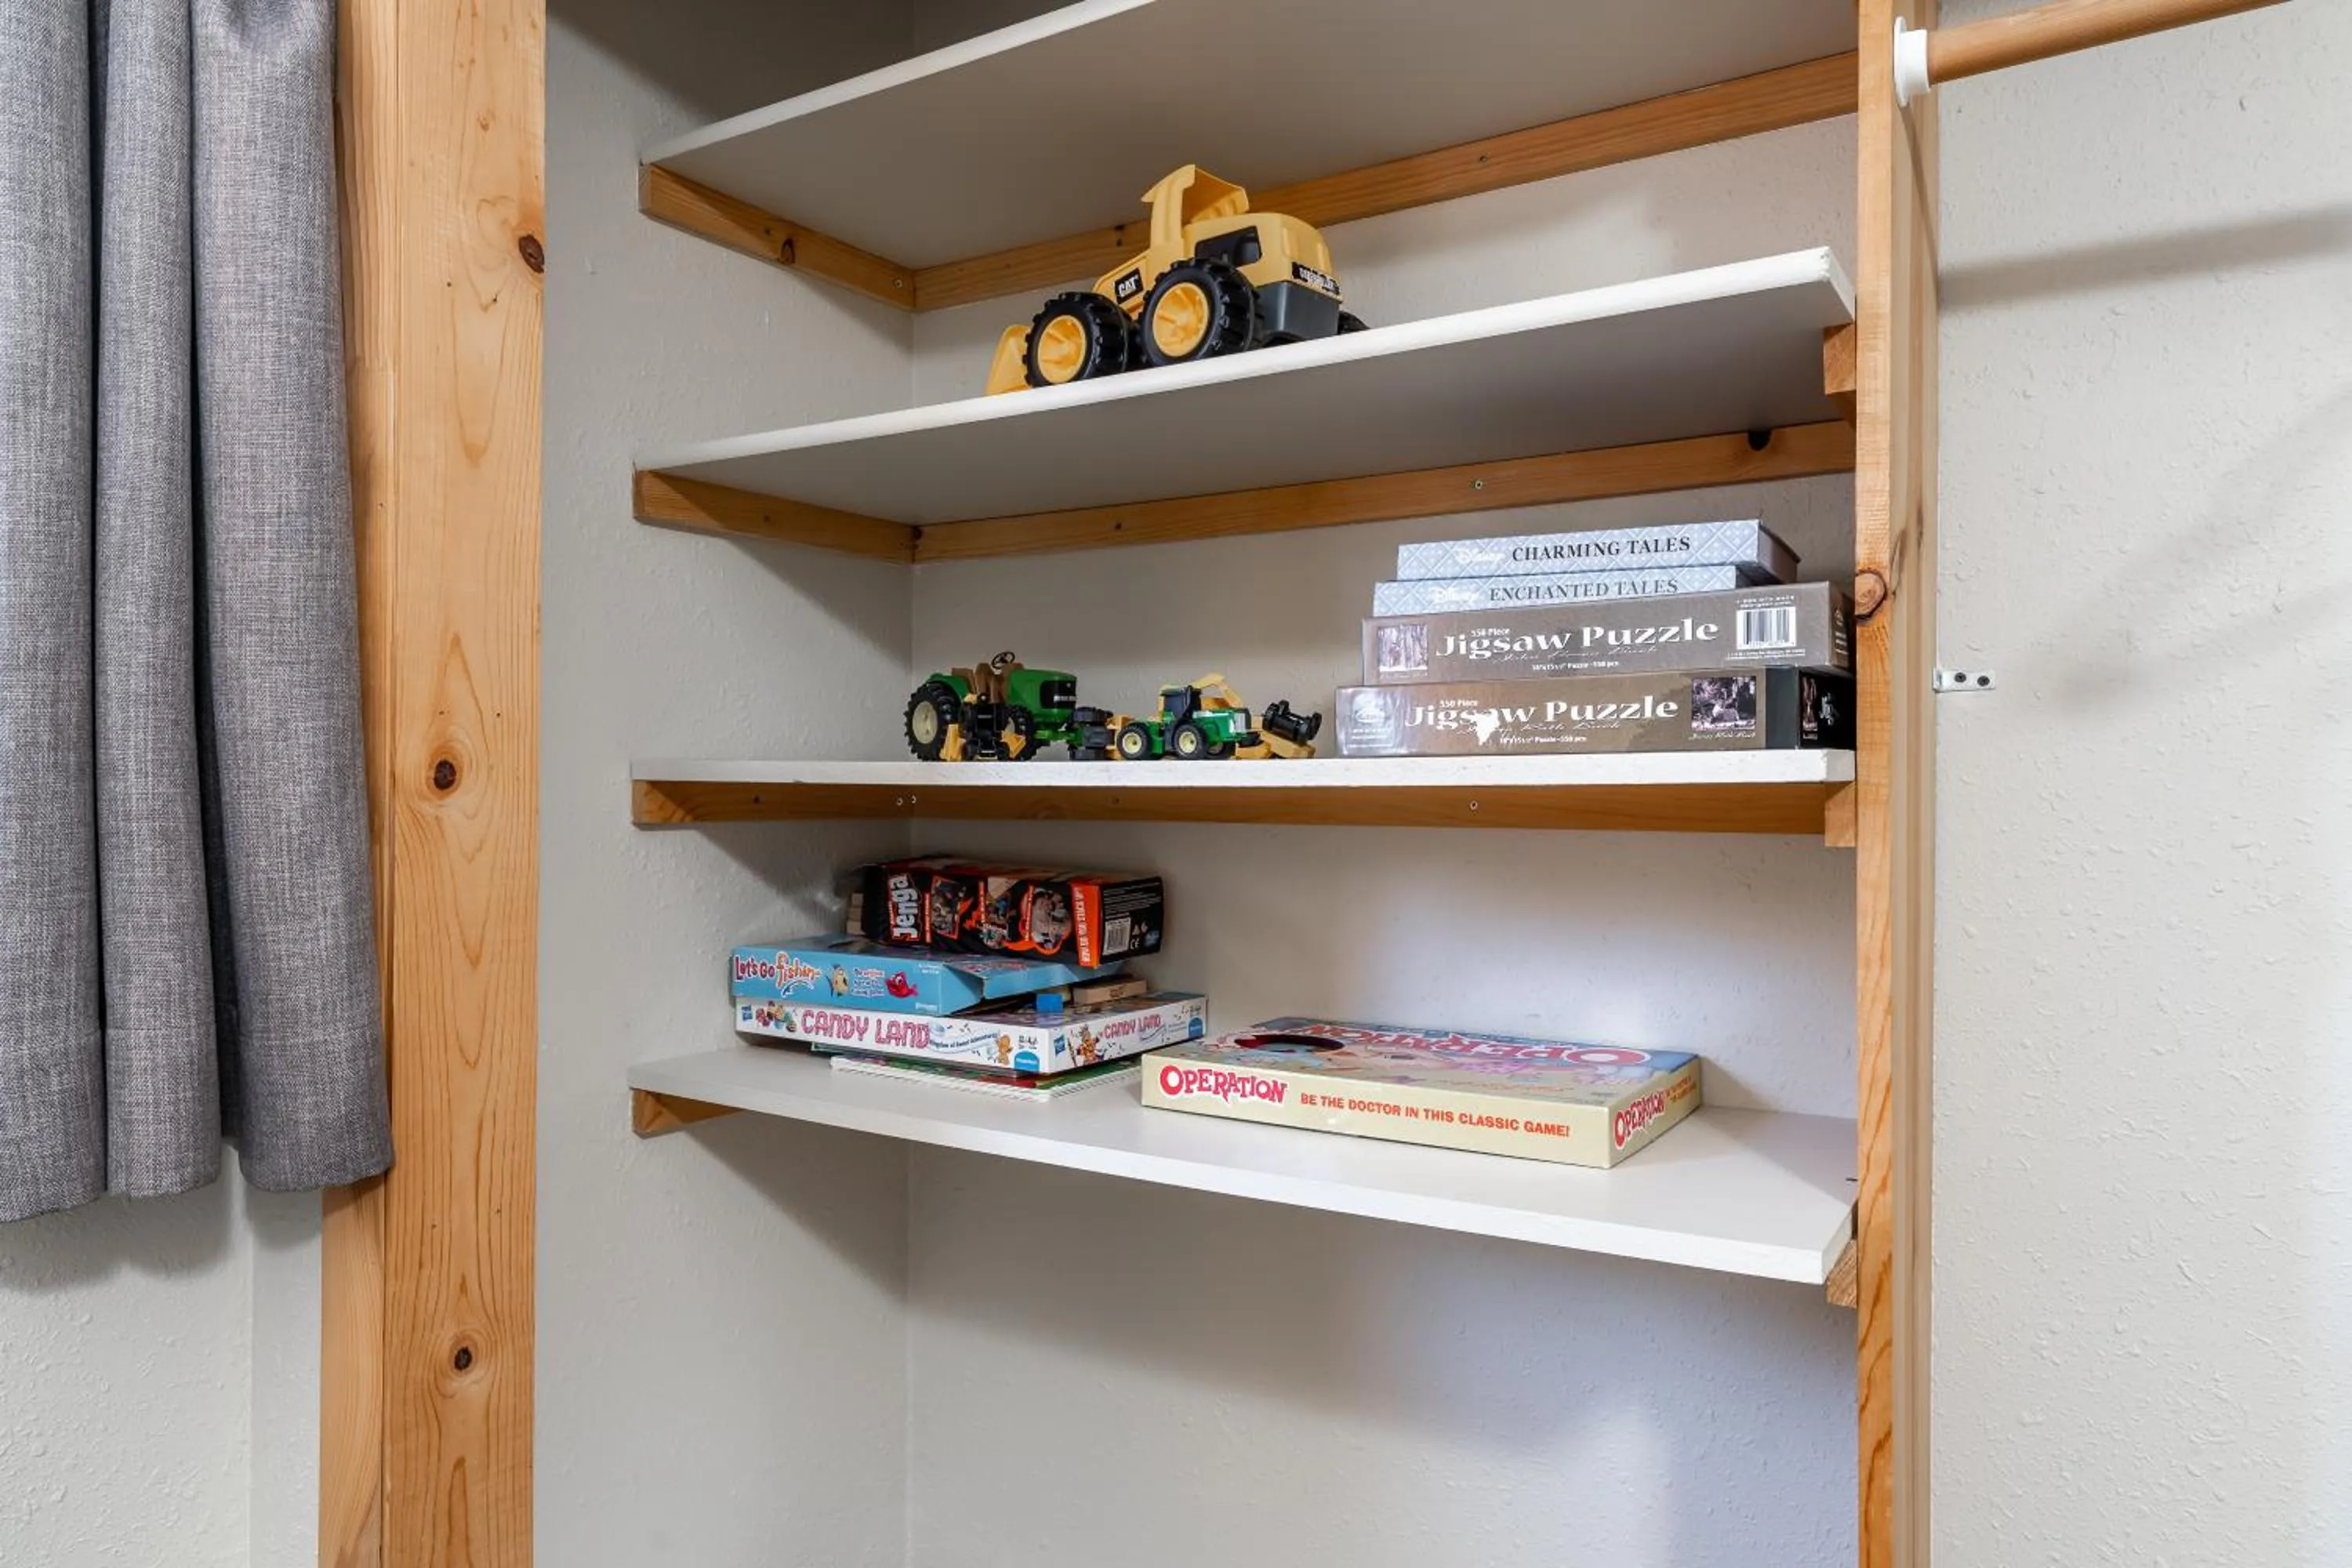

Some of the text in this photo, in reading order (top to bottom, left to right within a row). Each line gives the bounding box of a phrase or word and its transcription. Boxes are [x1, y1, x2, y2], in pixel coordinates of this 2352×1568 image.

[1118, 274, 1139, 297] CAT
[1512, 541, 1620, 562] CHARMING
[1627, 536, 1690, 555] TALES
[1490, 581, 1609, 601] ENCHANTED
[1614, 578, 1679, 596] TALES
[1436, 632, 1572, 659] Jigsaw
[1581, 616, 1719, 648] Puzzle
[1544, 695, 1679, 723] Puzzle
[891, 874, 918, 939] Jenga
[735, 955, 758, 981] Let's
[759, 960, 775, 979] Go
[801, 1009, 931, 1049] CANDY LAND
[1103, 1019, 1136, 1039] CANDY
[1138, 1014, 1161, 1032] LAND
[1300, 1092, 1570, 1137] BE THE DOCTOR IN THIS CLASSIC GAME!
